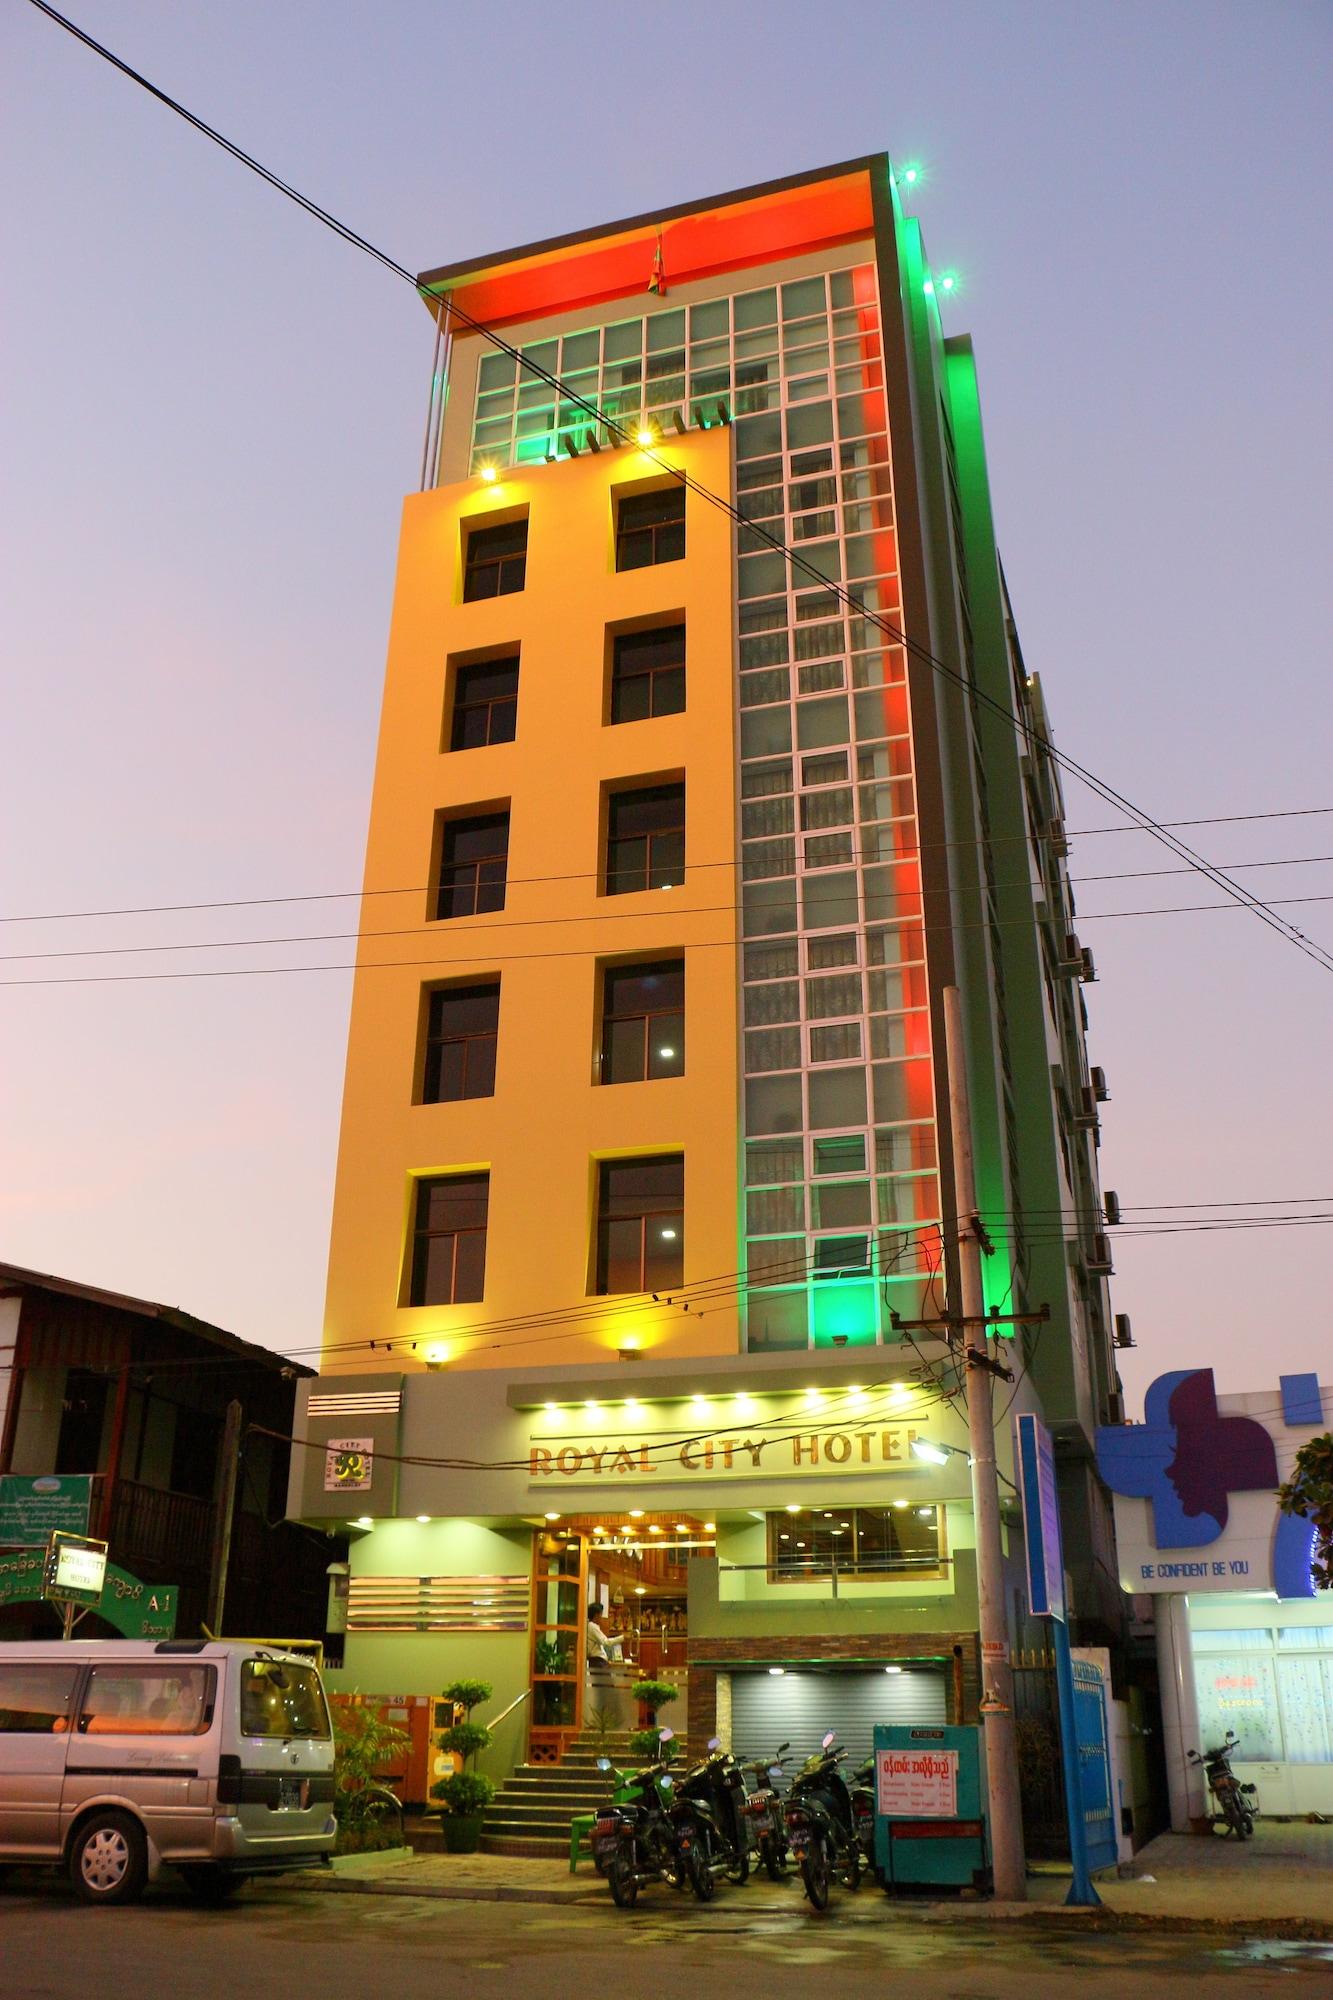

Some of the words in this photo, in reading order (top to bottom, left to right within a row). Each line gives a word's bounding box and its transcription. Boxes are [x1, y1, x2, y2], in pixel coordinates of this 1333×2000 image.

[529, 1443, 658, 1476] ROYAL
[680, 1438, 767, 1470] CITY
[1141, 1565, 1155, 1579] BE
[1157, 1563, 1208, 1578] CONFIDENT
[1212, 1562, 1226, 1576] BE
[1229, 1560, 1249, 1575] YOU
